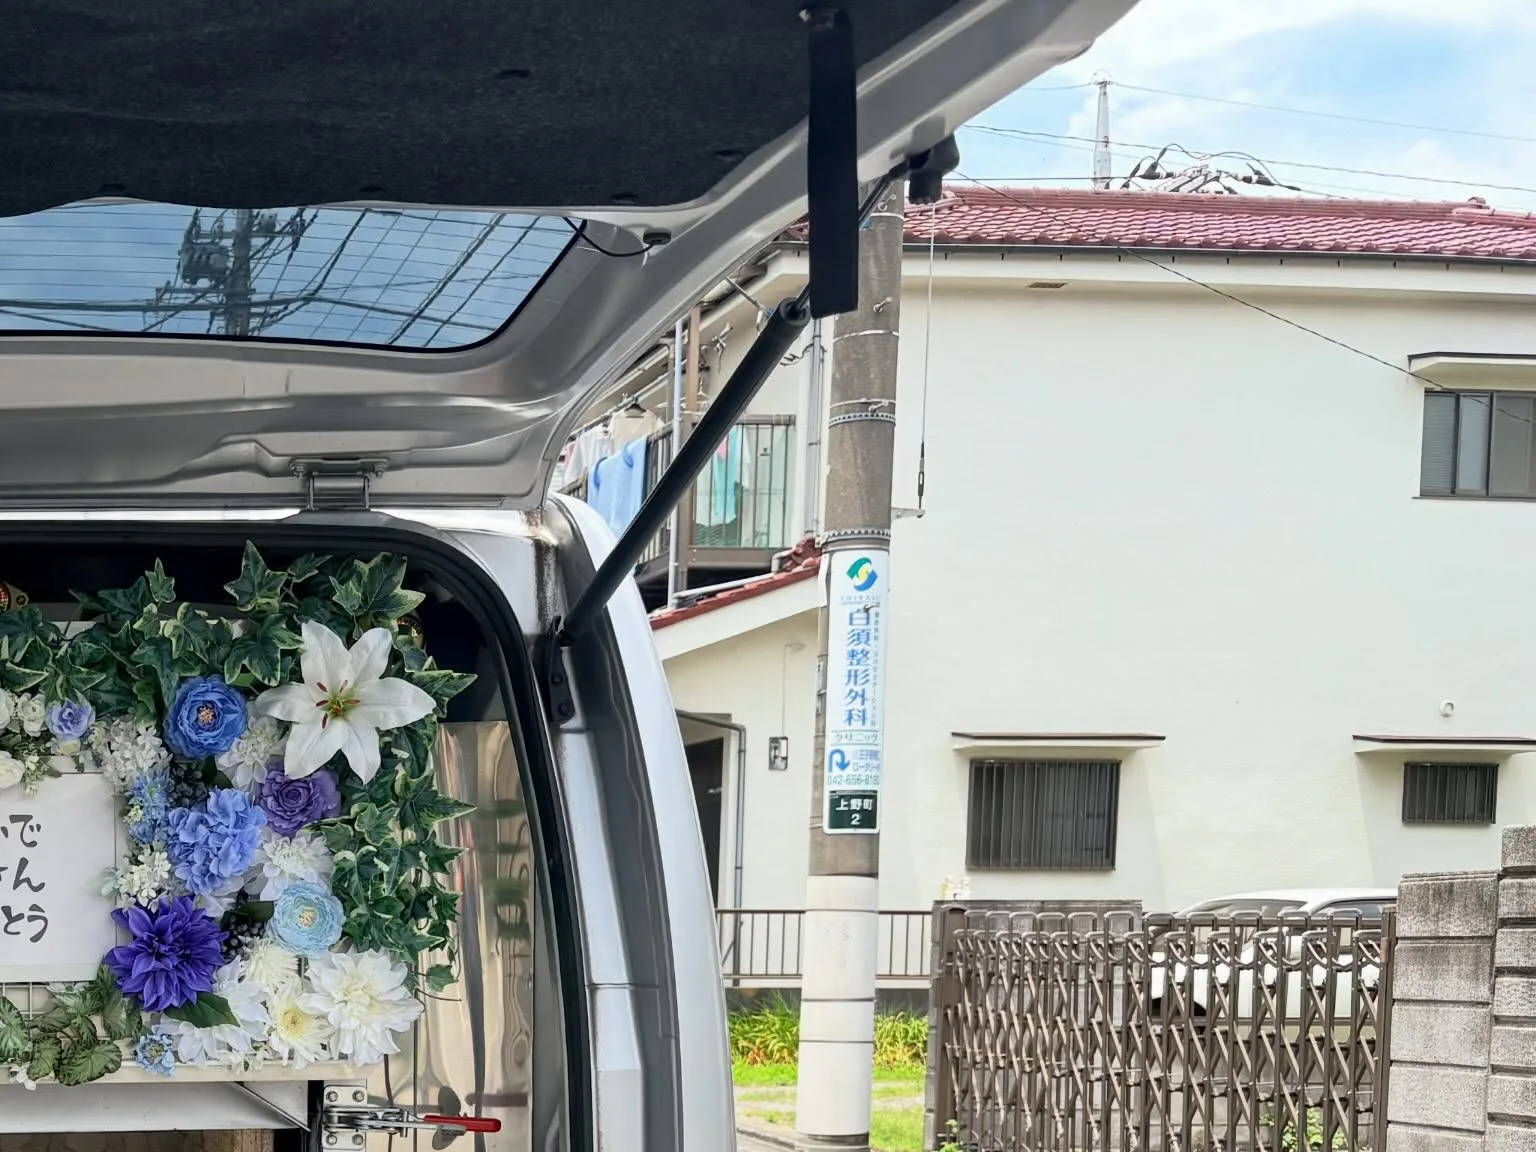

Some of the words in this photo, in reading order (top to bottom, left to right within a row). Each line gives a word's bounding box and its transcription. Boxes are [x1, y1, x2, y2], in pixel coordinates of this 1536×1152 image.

[843, 608, 871, 726] 白須整形外科
[834, 732, 879, 743] クリニック
[835, 798, 873, 811] 上野町
[850, 813, 861, 826] 2
